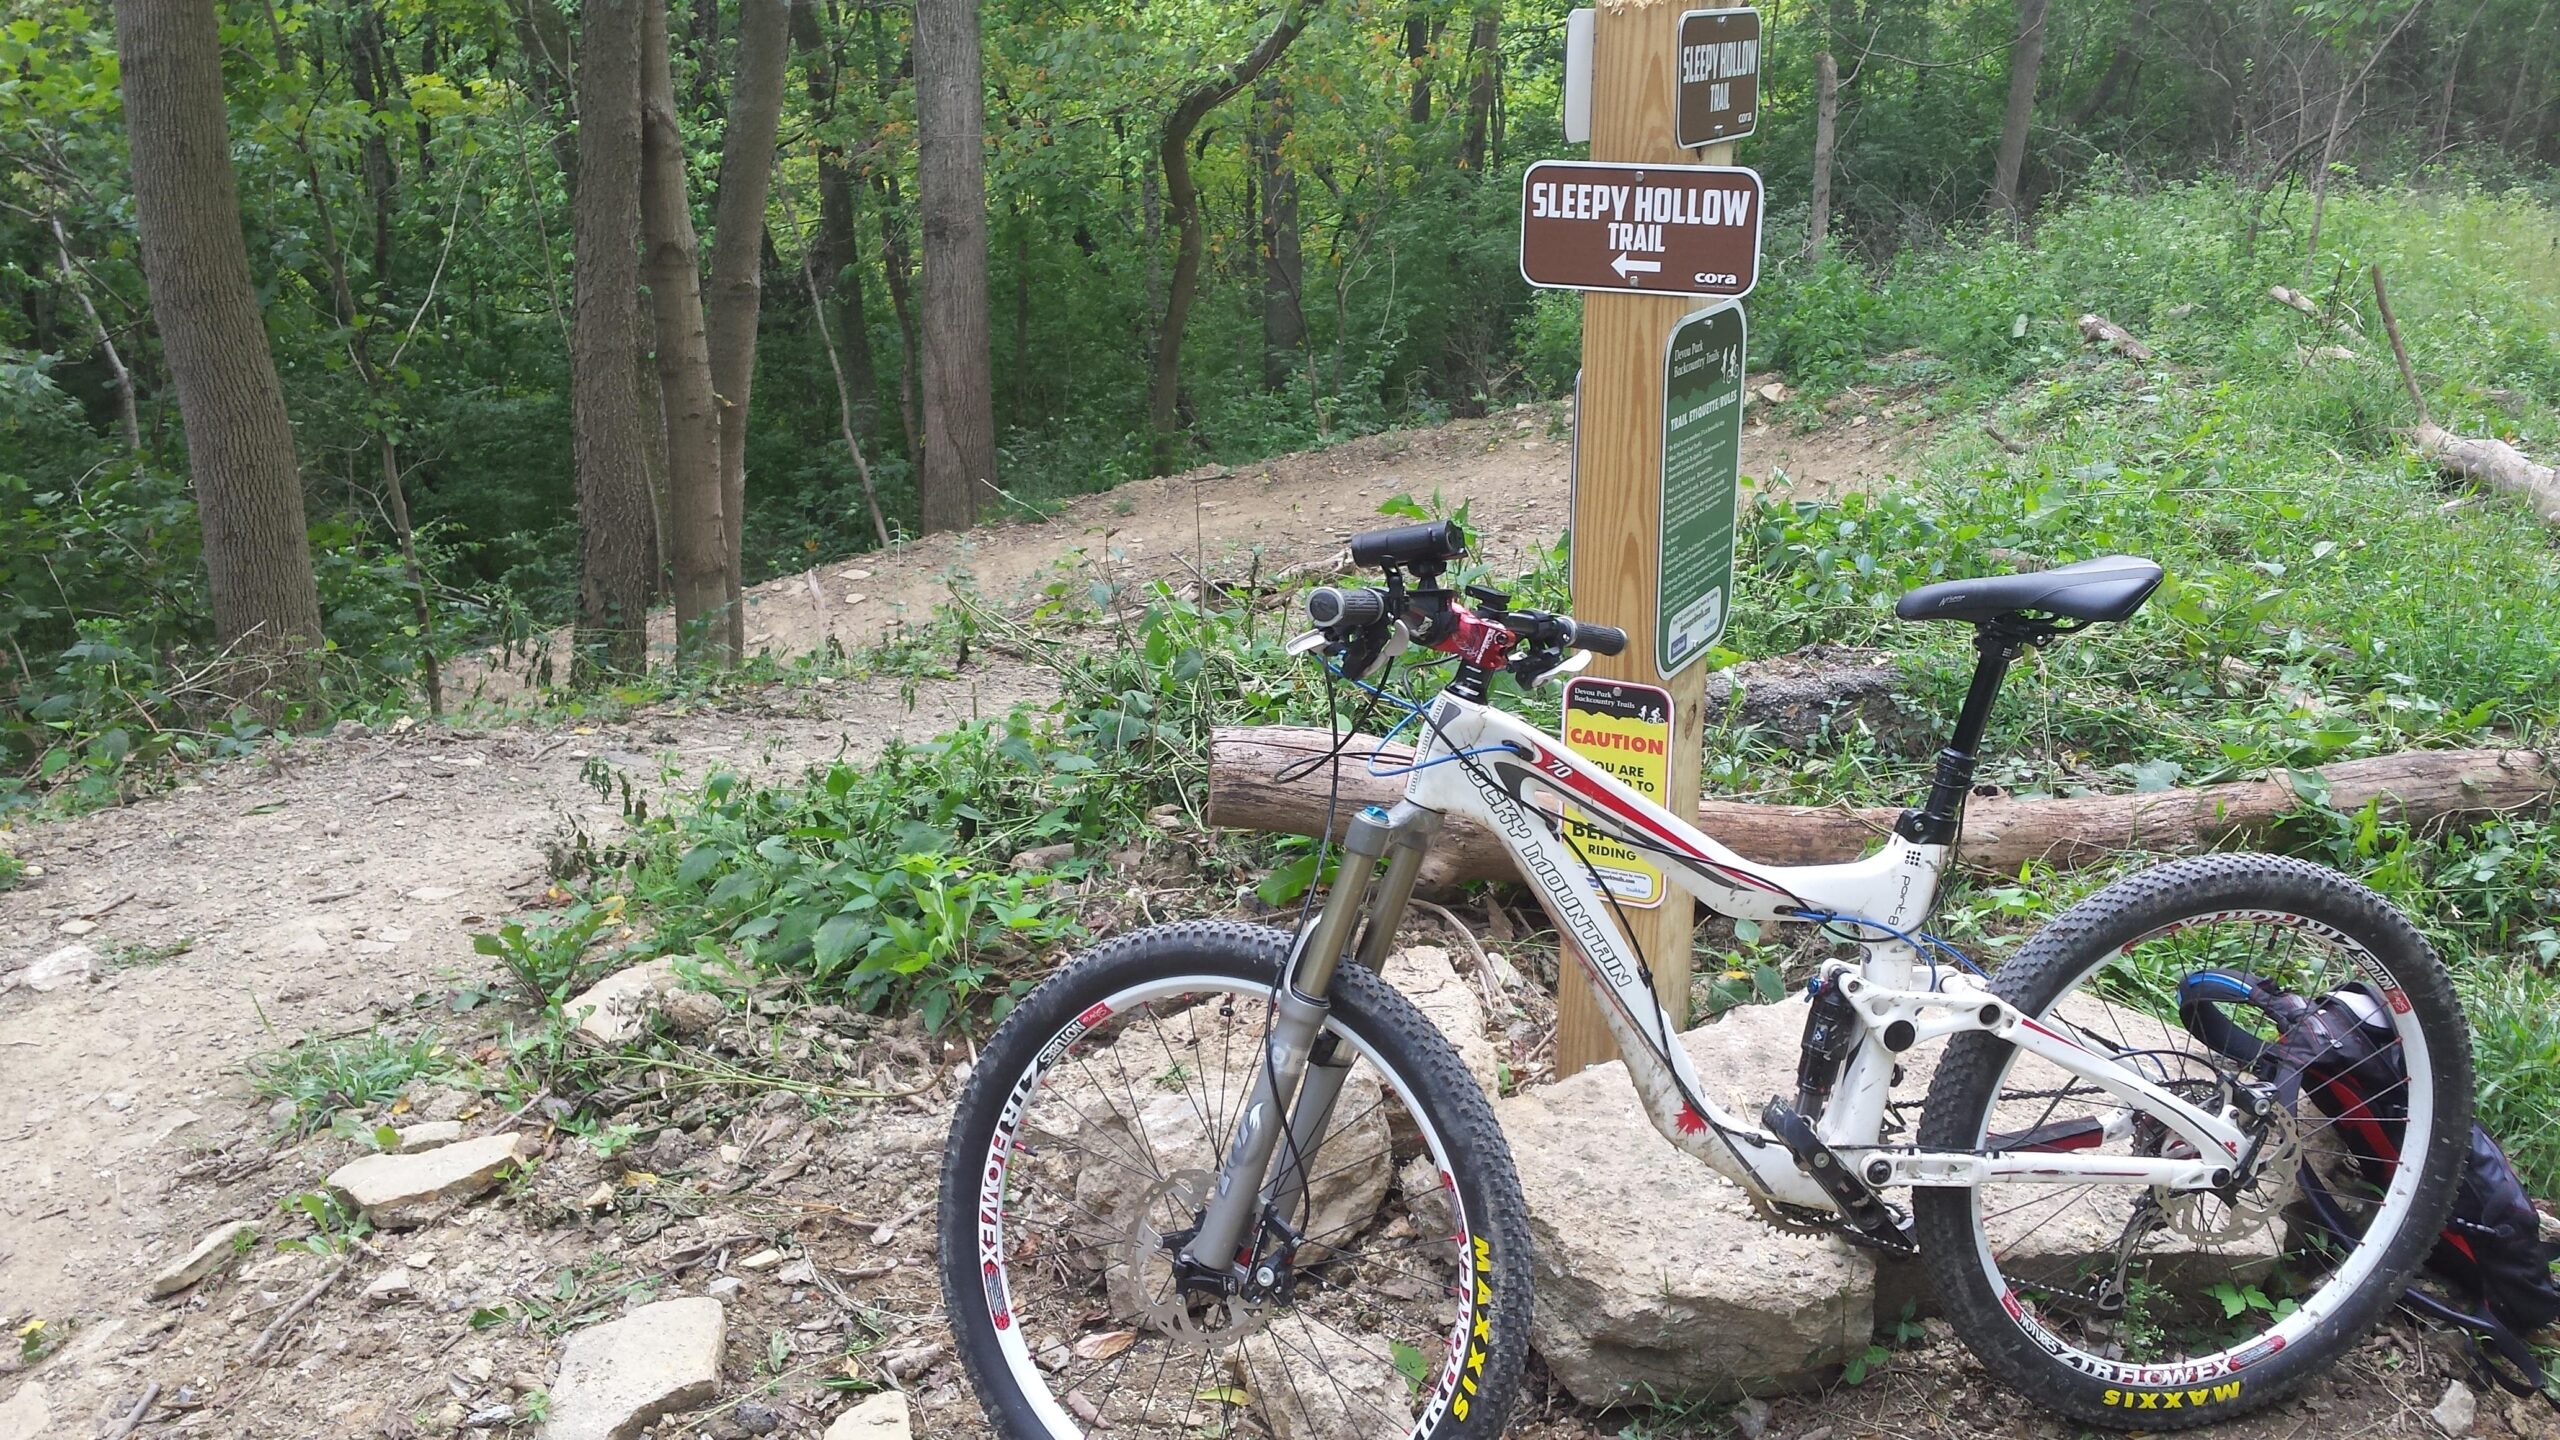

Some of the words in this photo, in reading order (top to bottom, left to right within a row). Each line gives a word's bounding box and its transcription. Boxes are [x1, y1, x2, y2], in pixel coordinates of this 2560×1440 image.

[1683, 43, 1720, 84] SLEEPY
[1720, 39, 1758, 79] HOLLOW
[1710, 82, 1730, 113] TRAIL
[1532, 182, 1631, 221] SLEEPY
[1634, 186, 1751, 227] HOLLOW
[1607, 222, 1666, 253] TRAIL
[1694, 272, 1737, 285] cora
[1670, 412, 1688, 432] TRAIL
[1689, 398, 1720, 424] ETIQUETTE
[1720, 389, 1738, 409] RULES
[1574, 687, 1595, 696] Devou
[1596, 690, 1612, 699] Park
[1574, 695, 1616, 708] Backcountry
[1616, 700, 1636, 709] Trails
[1570, 728, 1664, 756] CAUTION
[1545, 759, 1573, 779] 70
[1588, 760, 1615, 774] OU
[1618, 764, 1644, 778] ARE
[1636, 780, 1655, 793] TO
[1588, 844, 1637, 861] RIDING
[1521, 840, 1633, 988] MOUNTAIN
[1040, 1020, 1086, 1065] NOTUBES
[980, 1128, 1012, 1225] FLOW
[980, 1224, 1000, 1270] EX
[1453, 1234, 1493, 1423] MAXXIS
[2019, 1312, 2059, 1354] NOTUBES
[2116, 1364, 2199, 1386] FLOW
[2197, 1357, 2235, 1379] EX
[2102, 1380, 2240, 1410] MAXXIS
